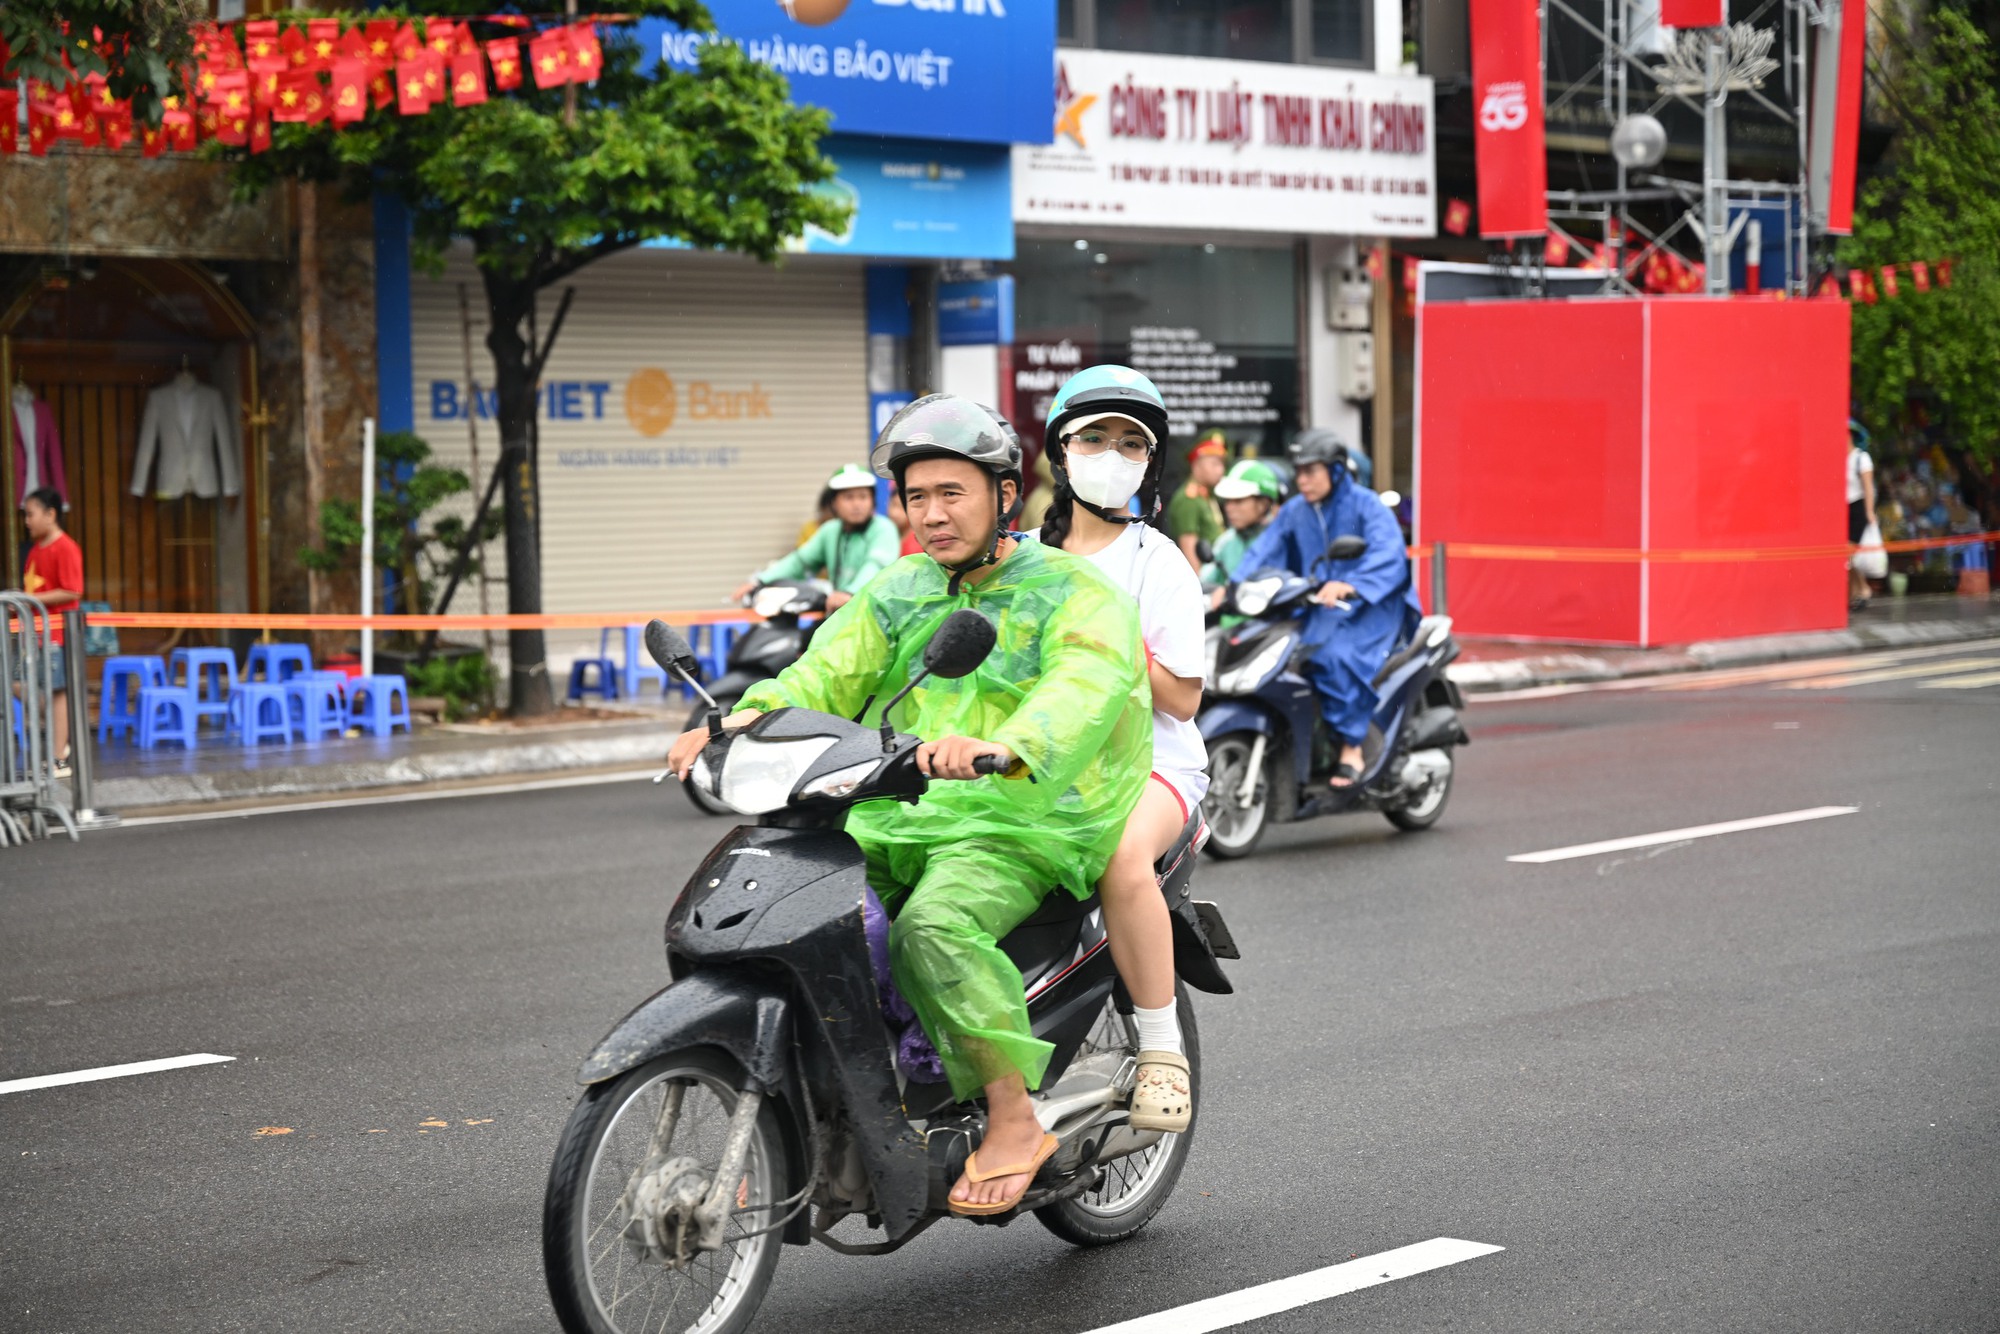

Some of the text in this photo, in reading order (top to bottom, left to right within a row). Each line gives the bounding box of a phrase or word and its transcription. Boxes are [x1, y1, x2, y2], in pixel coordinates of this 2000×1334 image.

[750, 33, 828, 76] HÀNG
[833, 38, 892, 81] BẢO
[892, 47, 953, 90] VIỆT
[1110, 73, 1166, 140] CÔNG
[1175, 88, 1197, 141] TY
[1206, 79, 1252, 153] LUẬT
[1263, 94, 1312, 148] TNHH
[688, 381, 773, 420] Bank
